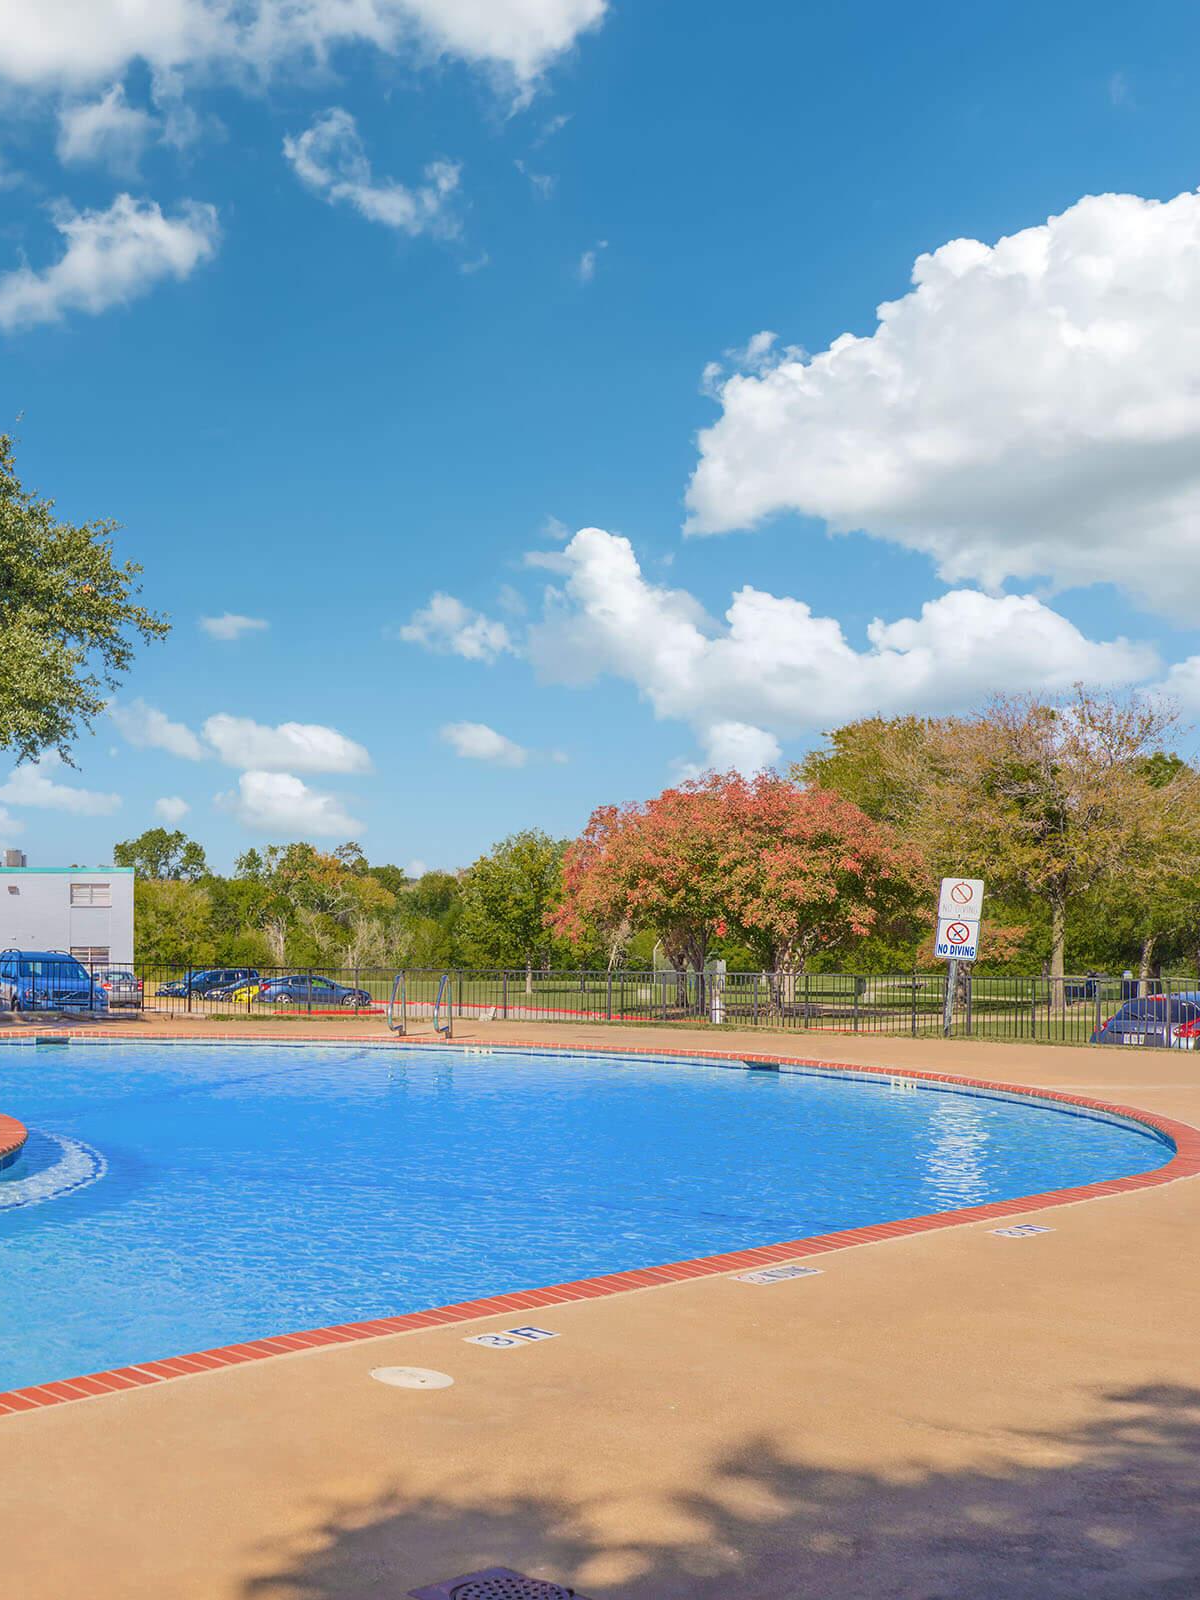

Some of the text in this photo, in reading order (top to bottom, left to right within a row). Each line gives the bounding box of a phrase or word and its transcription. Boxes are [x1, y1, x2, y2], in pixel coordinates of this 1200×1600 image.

[937, 943, 975, 957] NO DIVING
[477, 1335, 515, 1346] 3
